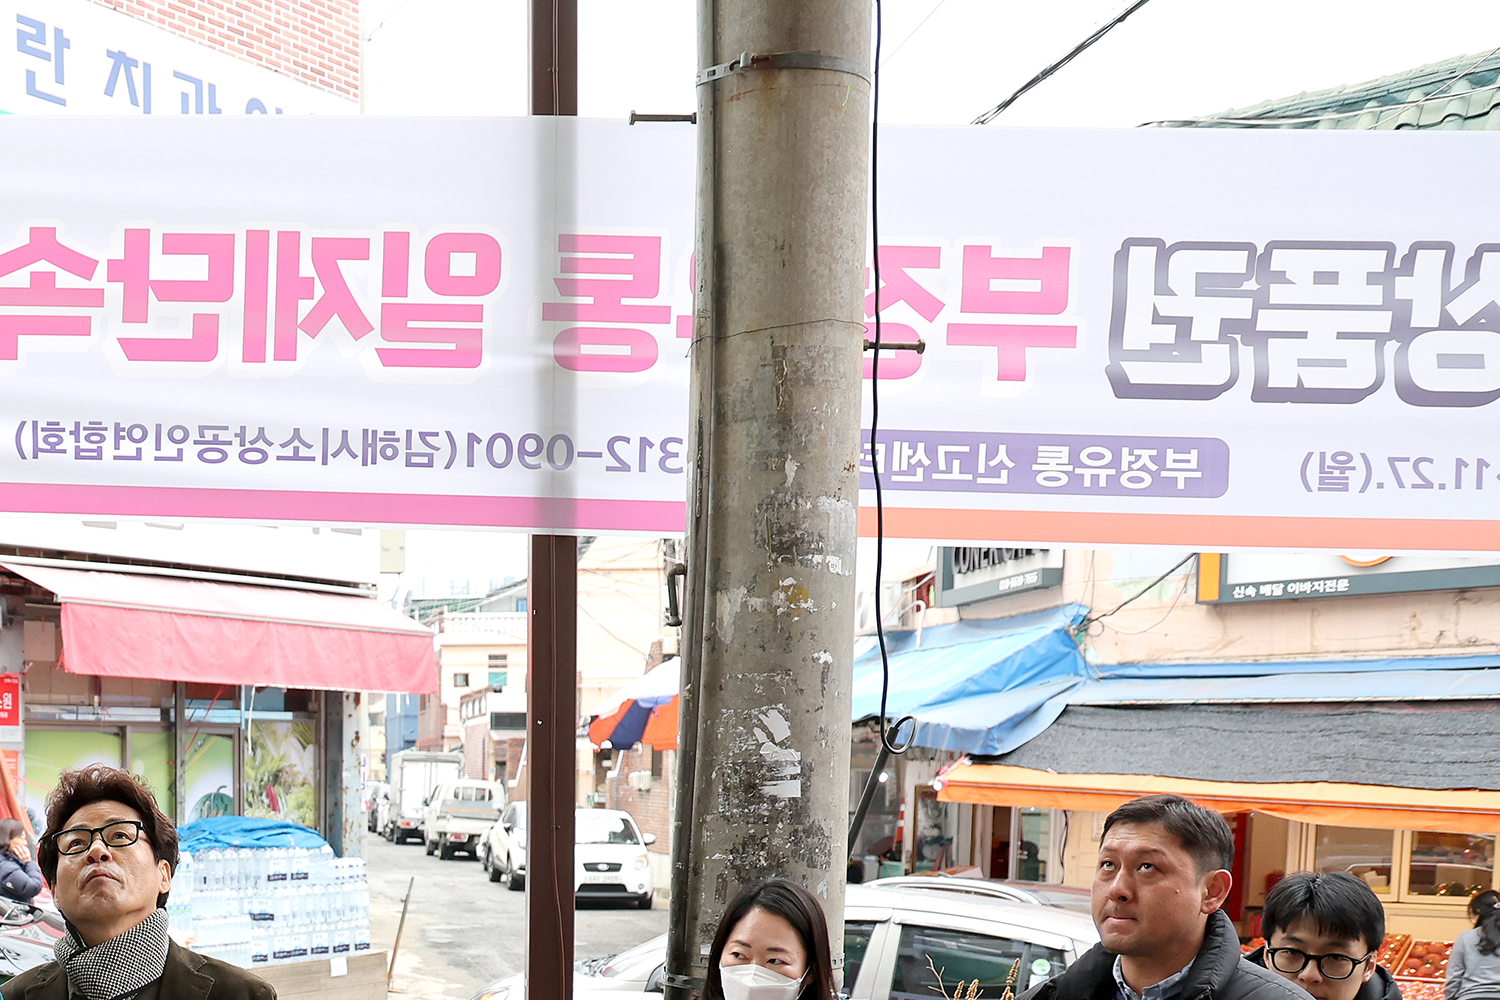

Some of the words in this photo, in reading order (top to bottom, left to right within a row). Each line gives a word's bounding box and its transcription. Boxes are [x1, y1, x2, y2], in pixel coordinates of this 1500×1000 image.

[1232, 585, 1257, 599] 신속
[1260, 583, 1284, 597] 배달
[1287, 578, 1351, 595] 이바지전문
